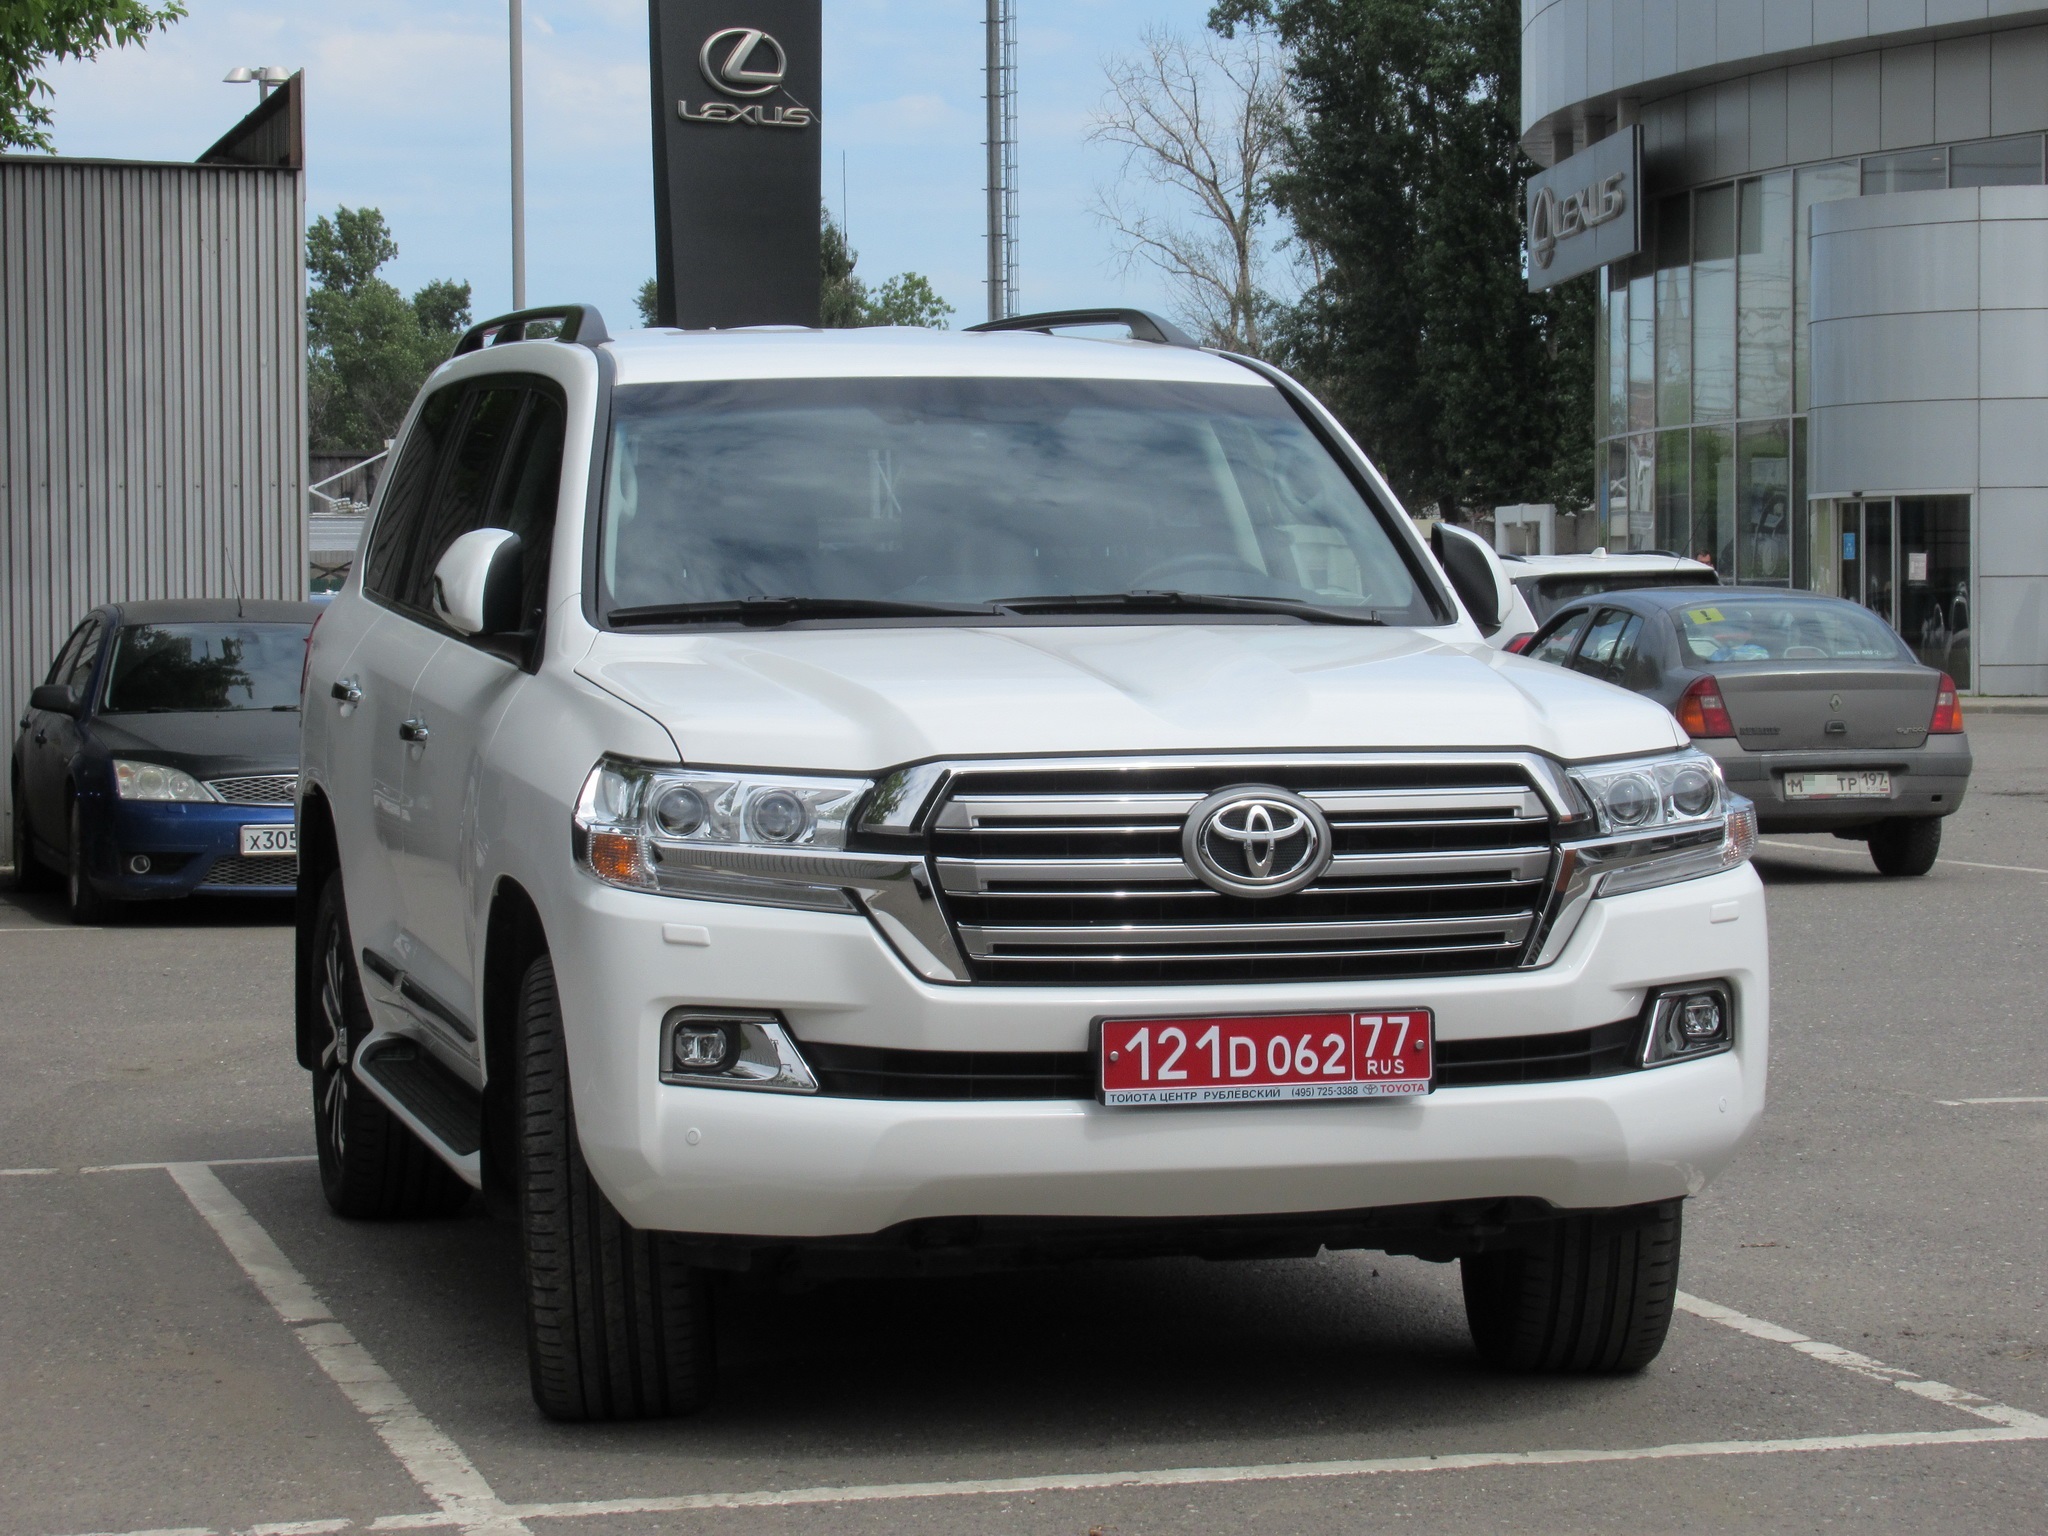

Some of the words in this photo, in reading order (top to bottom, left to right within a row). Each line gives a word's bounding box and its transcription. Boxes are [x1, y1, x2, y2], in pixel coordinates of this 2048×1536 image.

[678, 100, 811, 127] LEXUS
[1553, 172, 1624, 239] LEXUS
[1861, 773, 1884, 786] 197
[1360, 1016, 1410, 1058] 77
[1366, 1059, 1405, 1075] RUS
[1110, 1092, 1157, 1103] ТОЙОТА
[1160, 1091, 1198, 1103] ЦЕНТР
[1203, 1088, 1281, 1100] РУБЛЁВСКИЙ
[1291, 1087, 1315, 1097] (495)
[1317, 1085, 1359, 1096] 725-3388
[1380, 1083, 1425, 1094] TOYOTA
